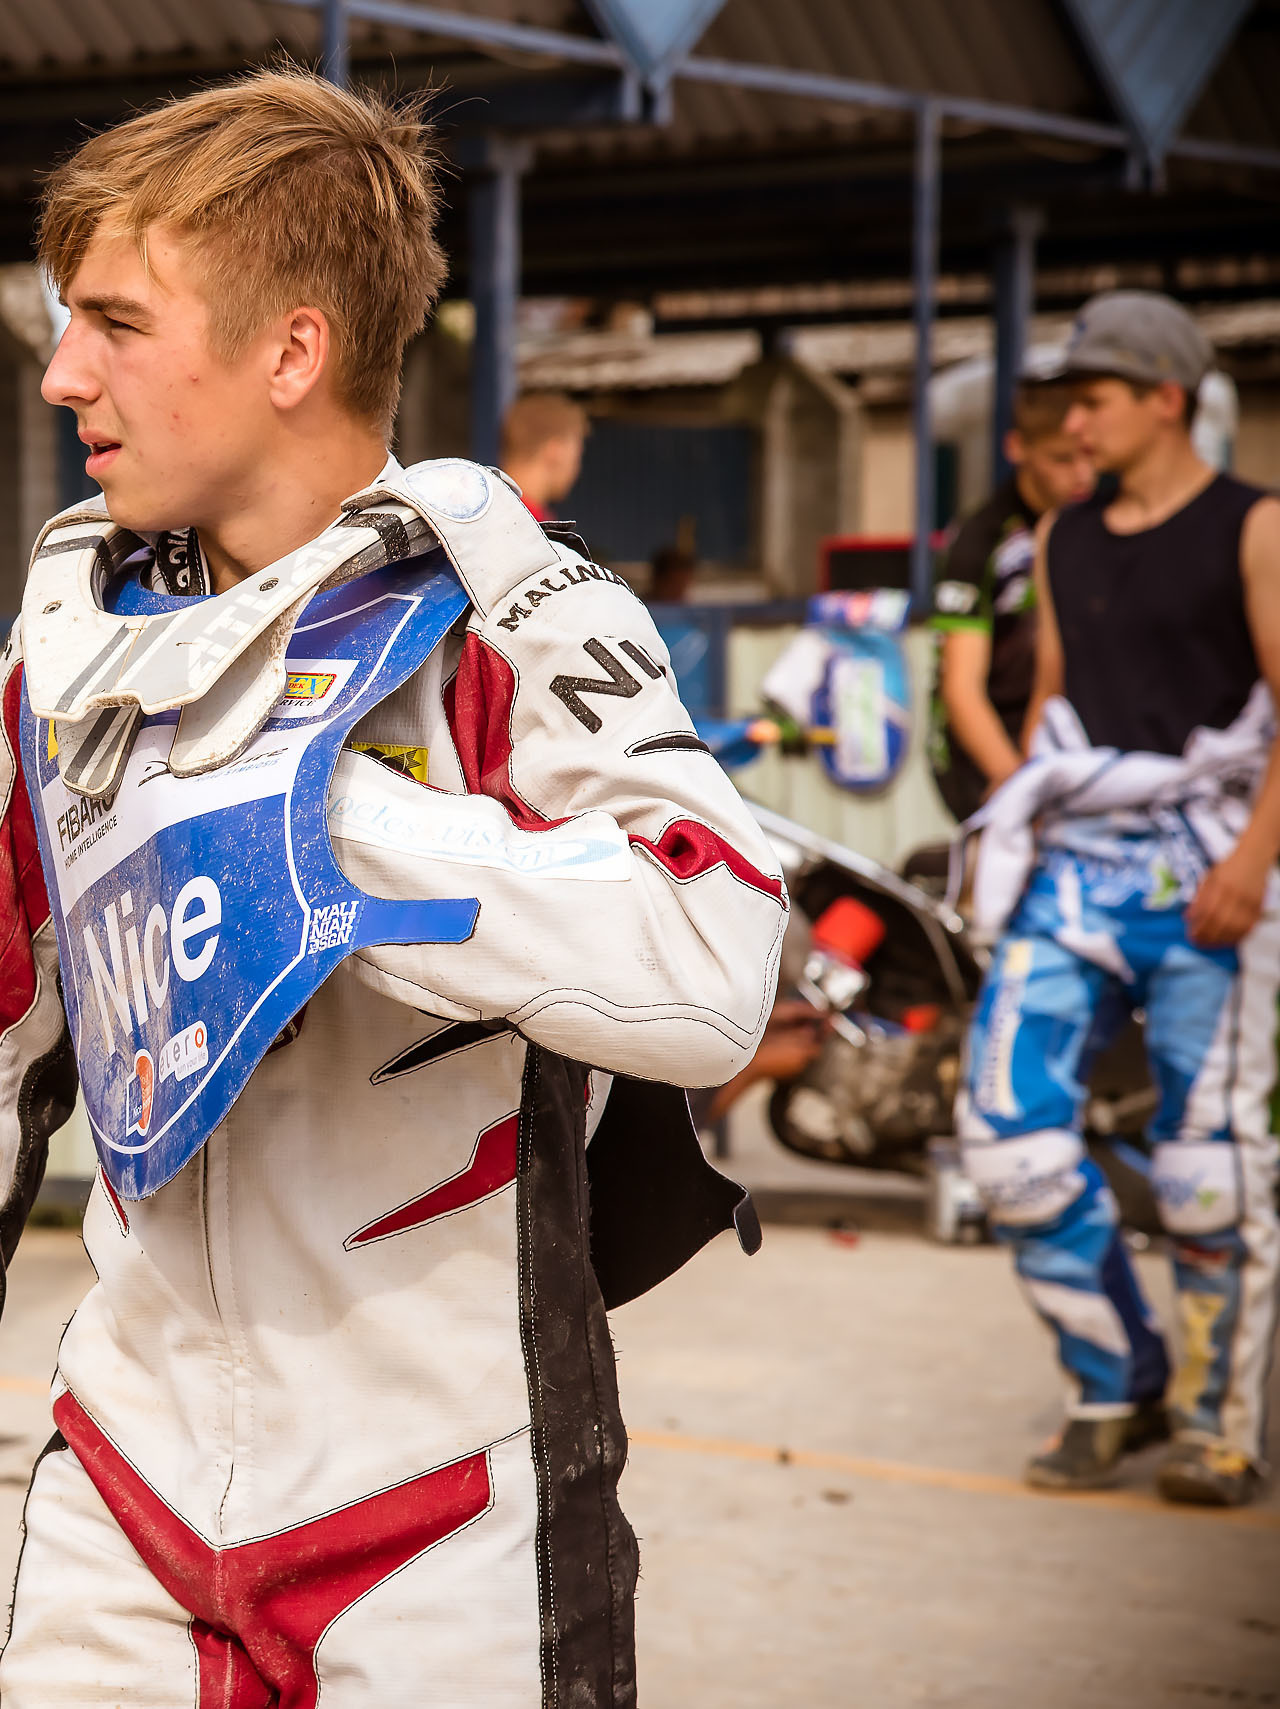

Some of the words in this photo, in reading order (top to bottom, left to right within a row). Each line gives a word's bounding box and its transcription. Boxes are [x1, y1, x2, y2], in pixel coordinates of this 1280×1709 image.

[312, 900, 360, 926] MALI
[83, 875, 222, 1057] Nice
[159, 1027, 205, 1076] elero
